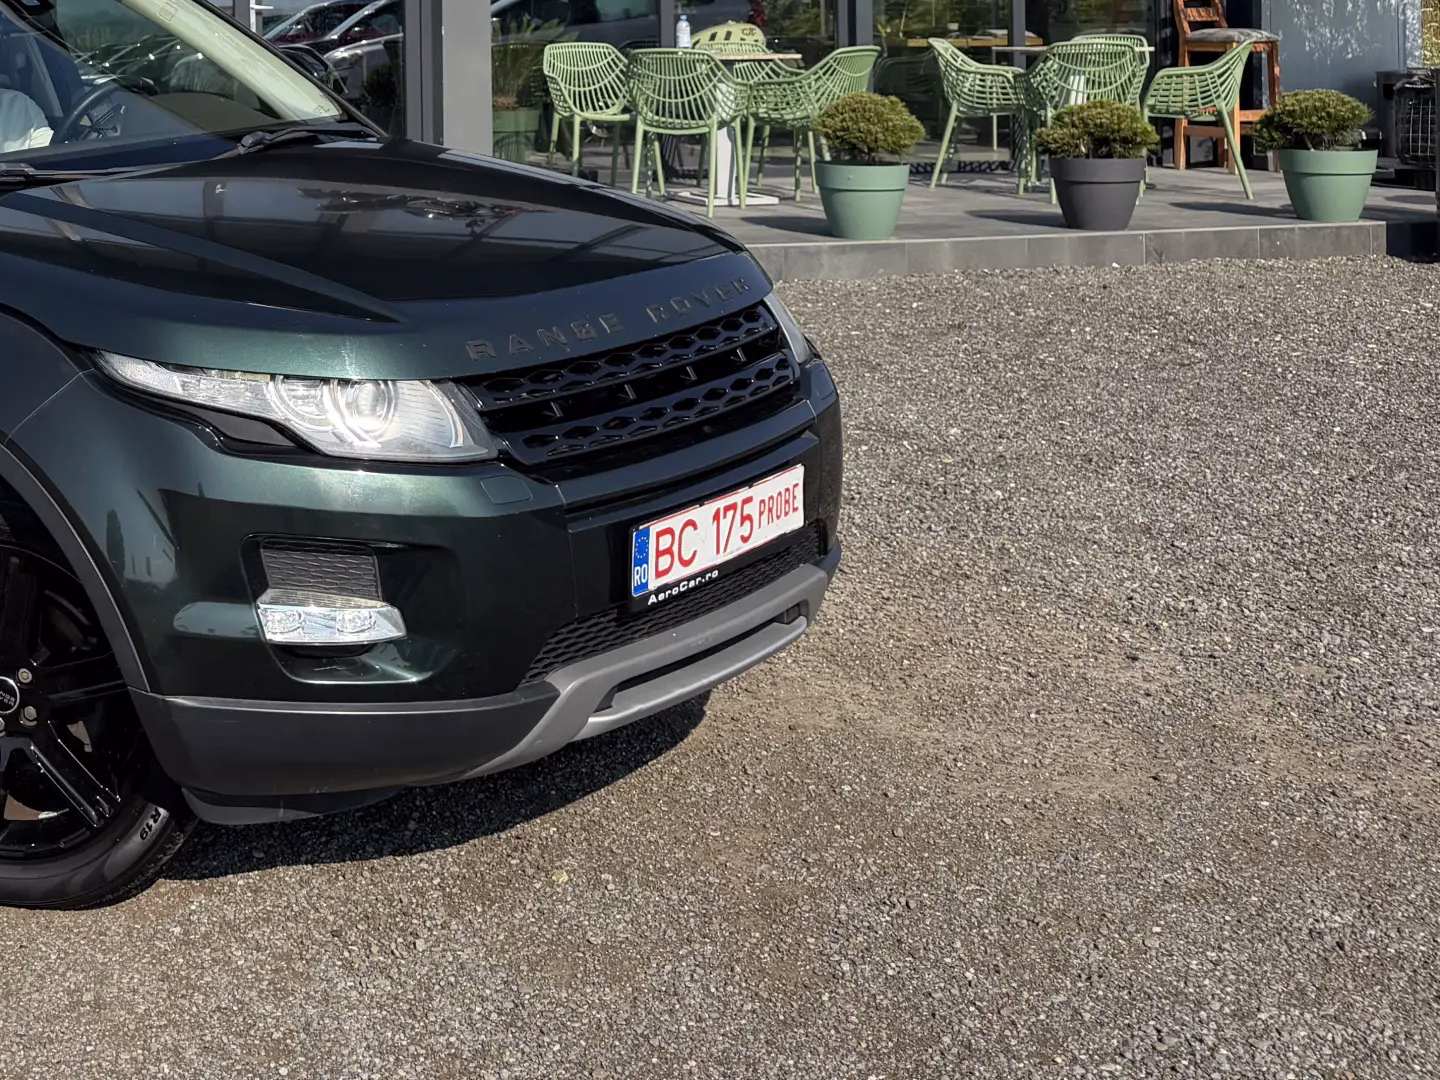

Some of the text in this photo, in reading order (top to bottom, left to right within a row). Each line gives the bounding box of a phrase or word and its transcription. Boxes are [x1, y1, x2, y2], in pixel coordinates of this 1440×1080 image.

[465, 275, 751, 360] RANGE ROVER
[654, 482, 800, 580] BC 175 PROBE
[634, 563, 648, 588] RO
[647, 569, 719, 606] AeroCar.ro
